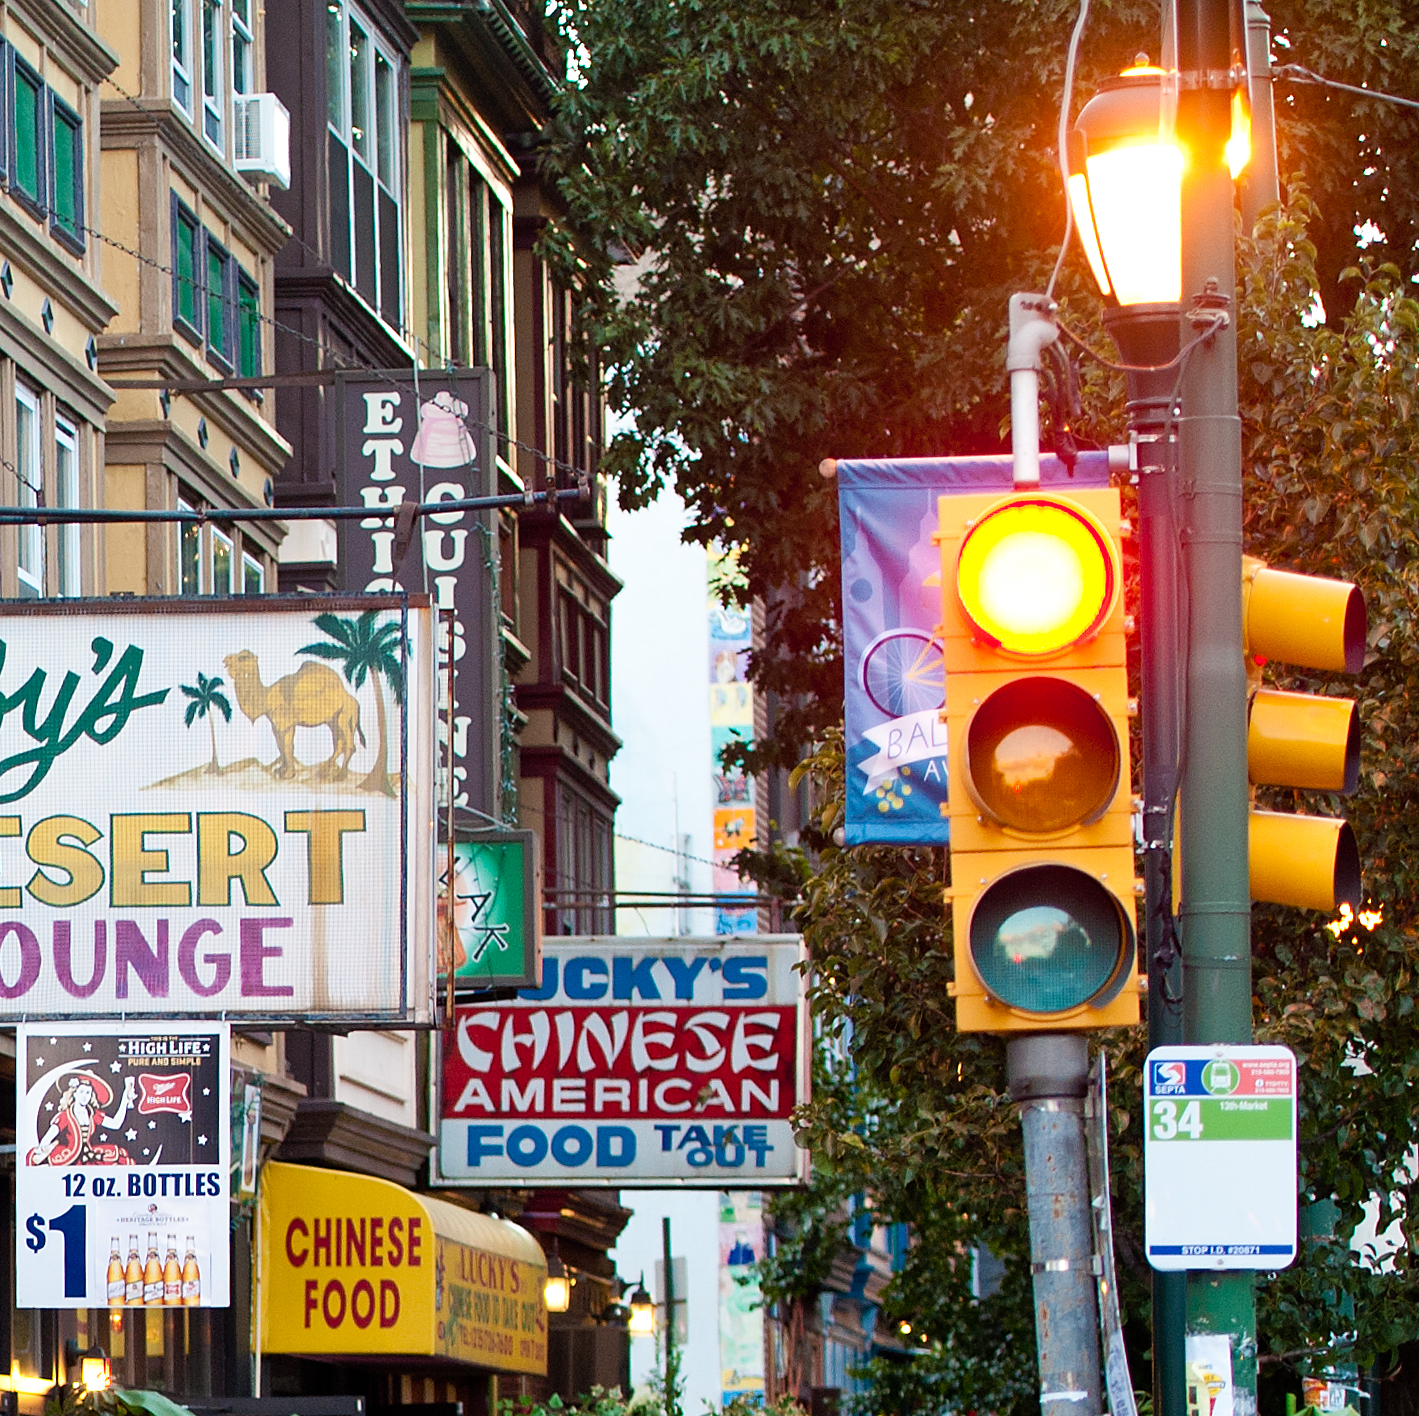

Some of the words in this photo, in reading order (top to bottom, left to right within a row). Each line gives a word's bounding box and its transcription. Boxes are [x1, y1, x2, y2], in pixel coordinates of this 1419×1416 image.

[360, 391, 406, 593] ETHI
[511, 956, 768, 1001] UCKY'S
[128, 1040, 167, 1055] HIGH
[169, 1040, 202, 1055] LIFE
[457, 1009, 781, 1074] CHINESE
[152, 1057, 169, 1067] AND
[454, 1077, 780, 1113] AMERICAN
[1155, 1085, 1186, 1095] SEPTA
[1153, 1100, 1204, 1140] 34
[467, 1124, 637, 1168] FOOD
[654, 1124, 769, 1152] TAKE
[686, 1146, 774, 1168] OUT
[62, 1173, 86, 1198] 12
[92, 1176, 122, 1198] oz.
[127, 1173, 221, 1197] BOTTLES
[285, 1217, 422, 1268] CHINESE
[1181, 1245, 1208, 1255] STOP
[304, 1279, 401, 1329] FOOD
